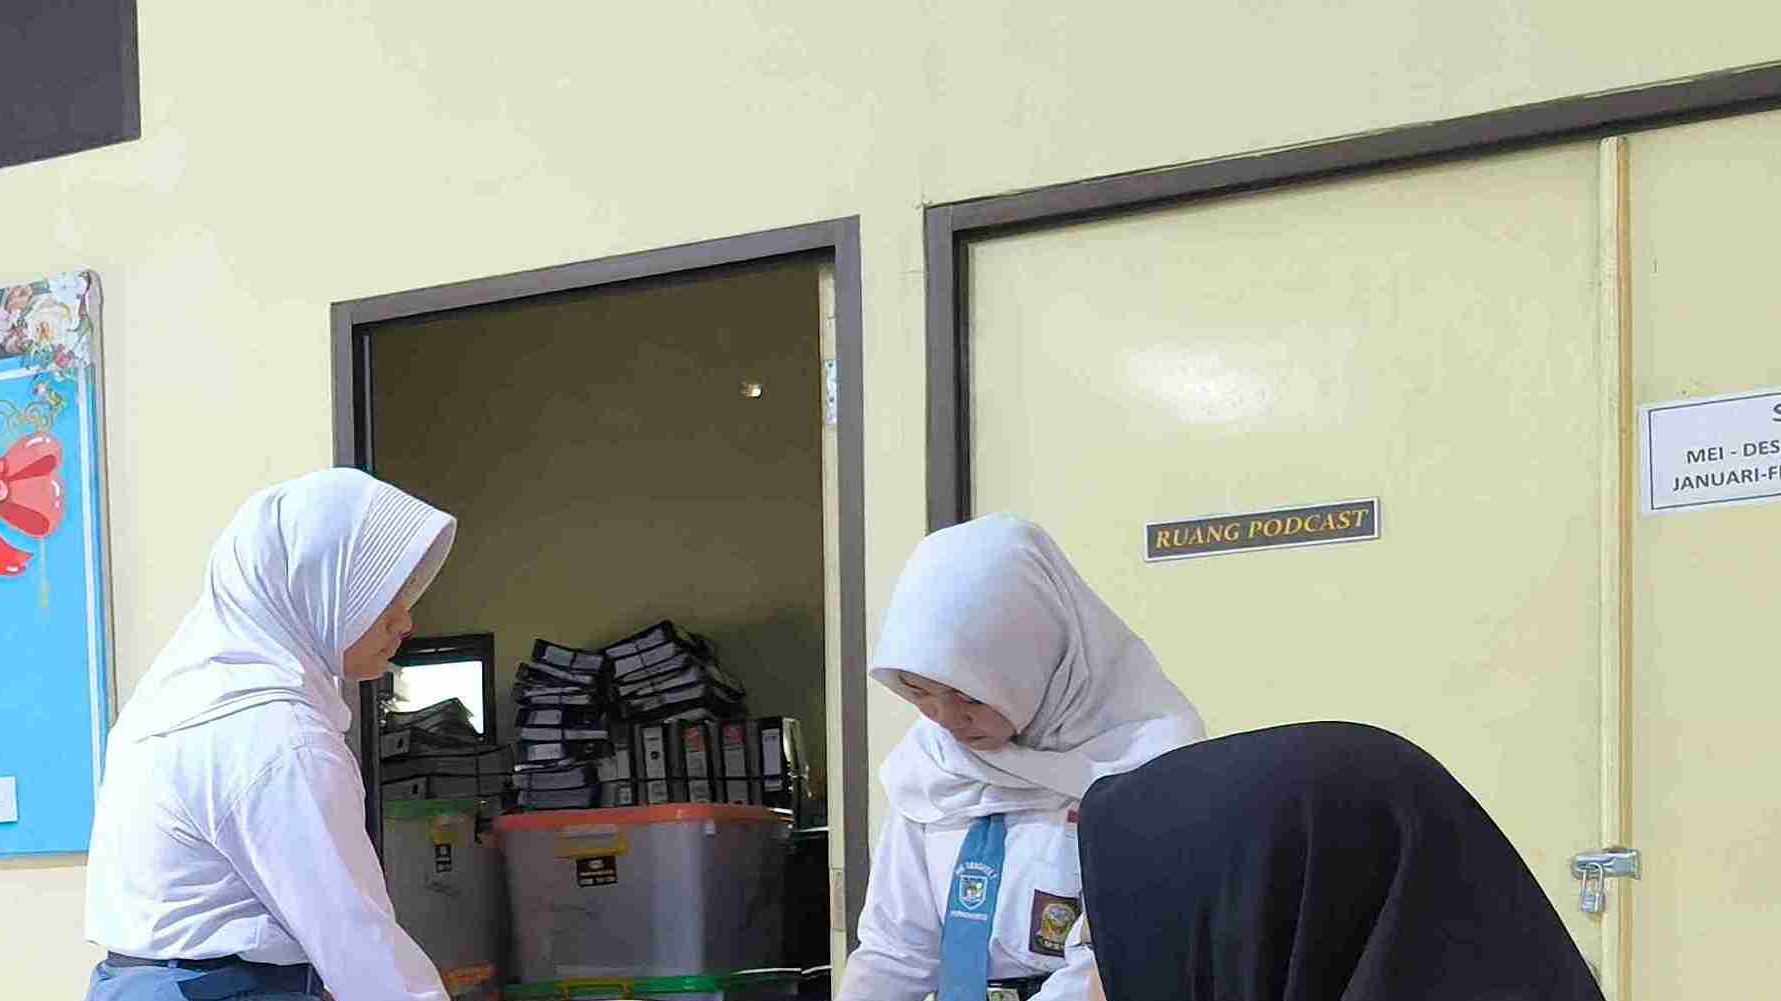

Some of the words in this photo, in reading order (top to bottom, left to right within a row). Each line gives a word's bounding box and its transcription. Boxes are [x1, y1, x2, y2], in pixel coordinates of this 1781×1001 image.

[1686, 446, 1724, 465] MEI
[1743, 440, 1781, 457] DES
[1155, 522, 1242, 550] RUANG
[1248, 508, 1371, 540] PODCAST
